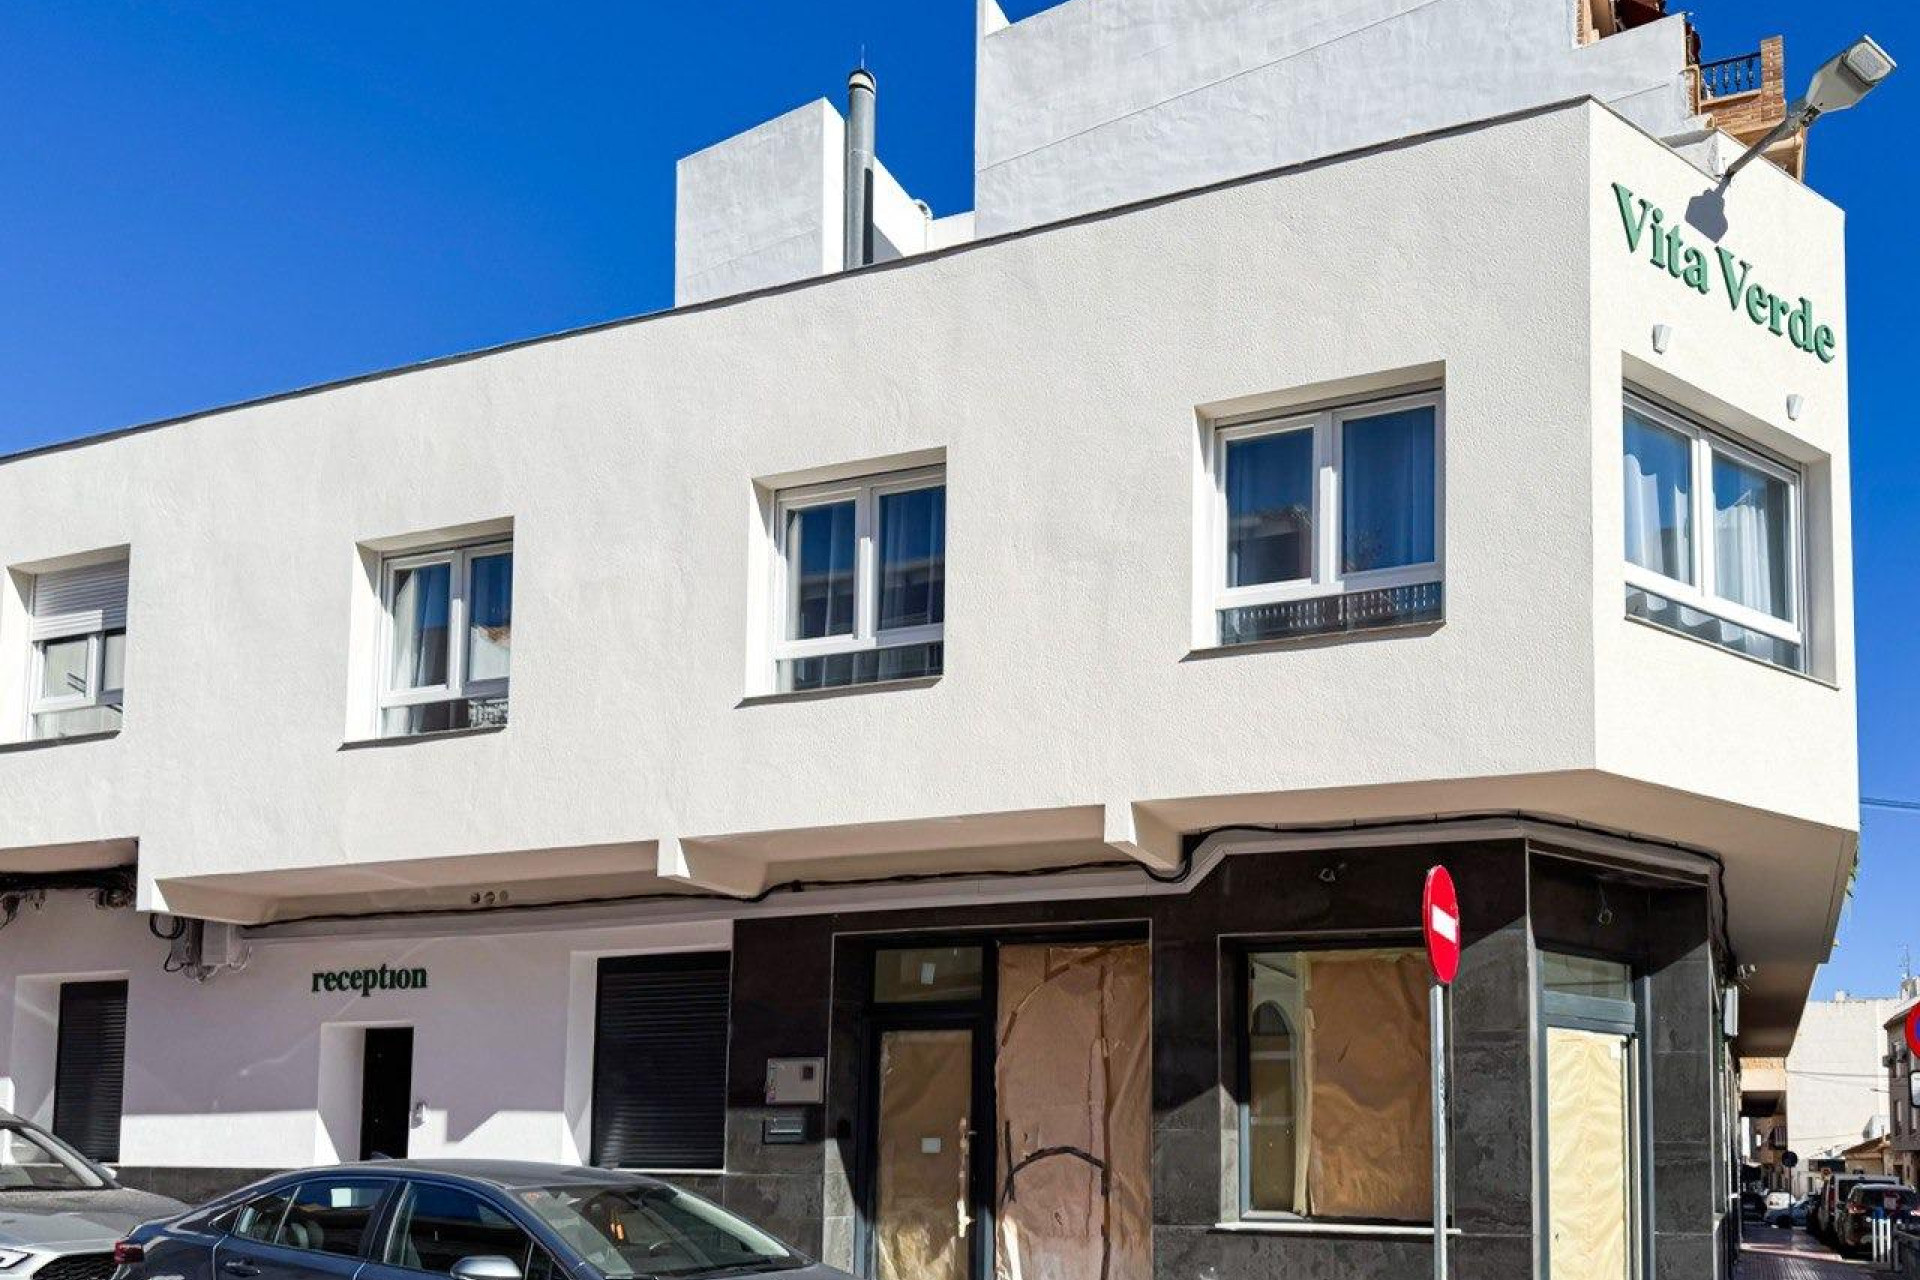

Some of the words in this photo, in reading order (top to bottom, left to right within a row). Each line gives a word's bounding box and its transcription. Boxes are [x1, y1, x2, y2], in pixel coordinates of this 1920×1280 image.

[1611, 182, 1710, 295] Vita
[1714, 246, 1835, 363] Verde
[311, 963, 427, 997] reception
